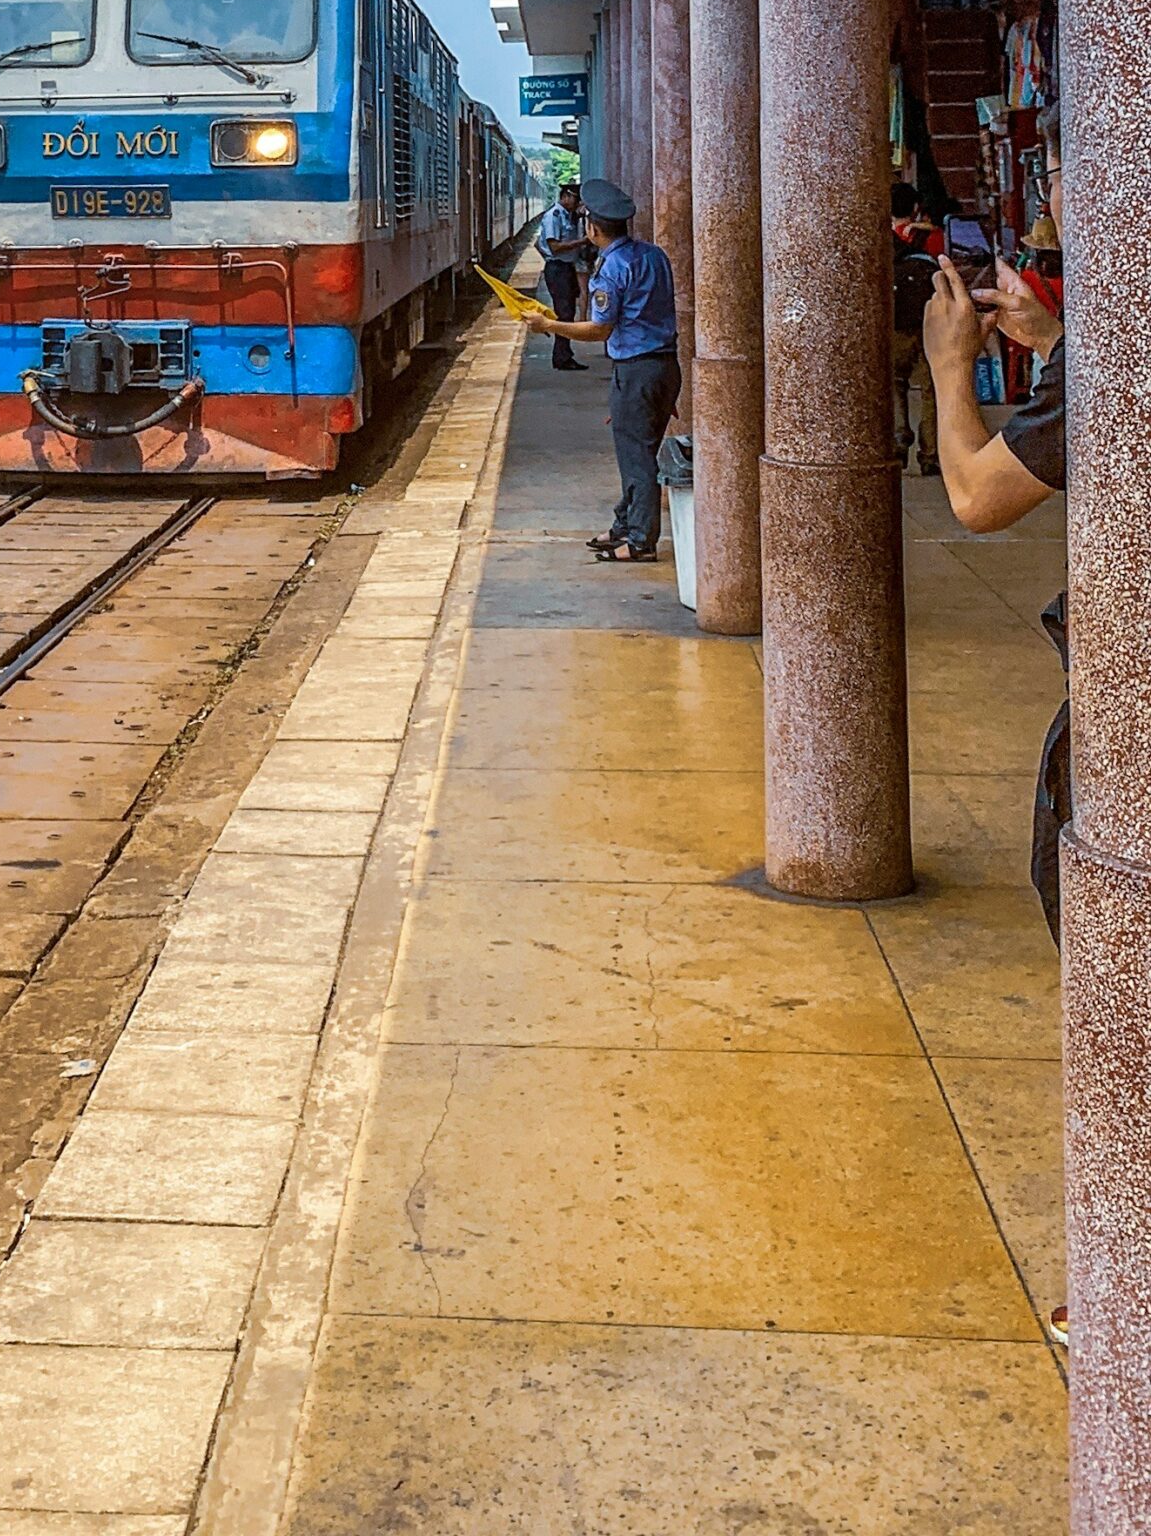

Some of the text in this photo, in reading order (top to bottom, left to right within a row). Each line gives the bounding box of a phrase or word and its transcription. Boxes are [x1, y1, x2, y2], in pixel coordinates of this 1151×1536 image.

[522, 91, 552, 99] TRACK
[573, 80, 585, 97] 1
[42, 119, 179, 156] ĐỔI MỚI
[54, 190, 165, 215] D19E-928
